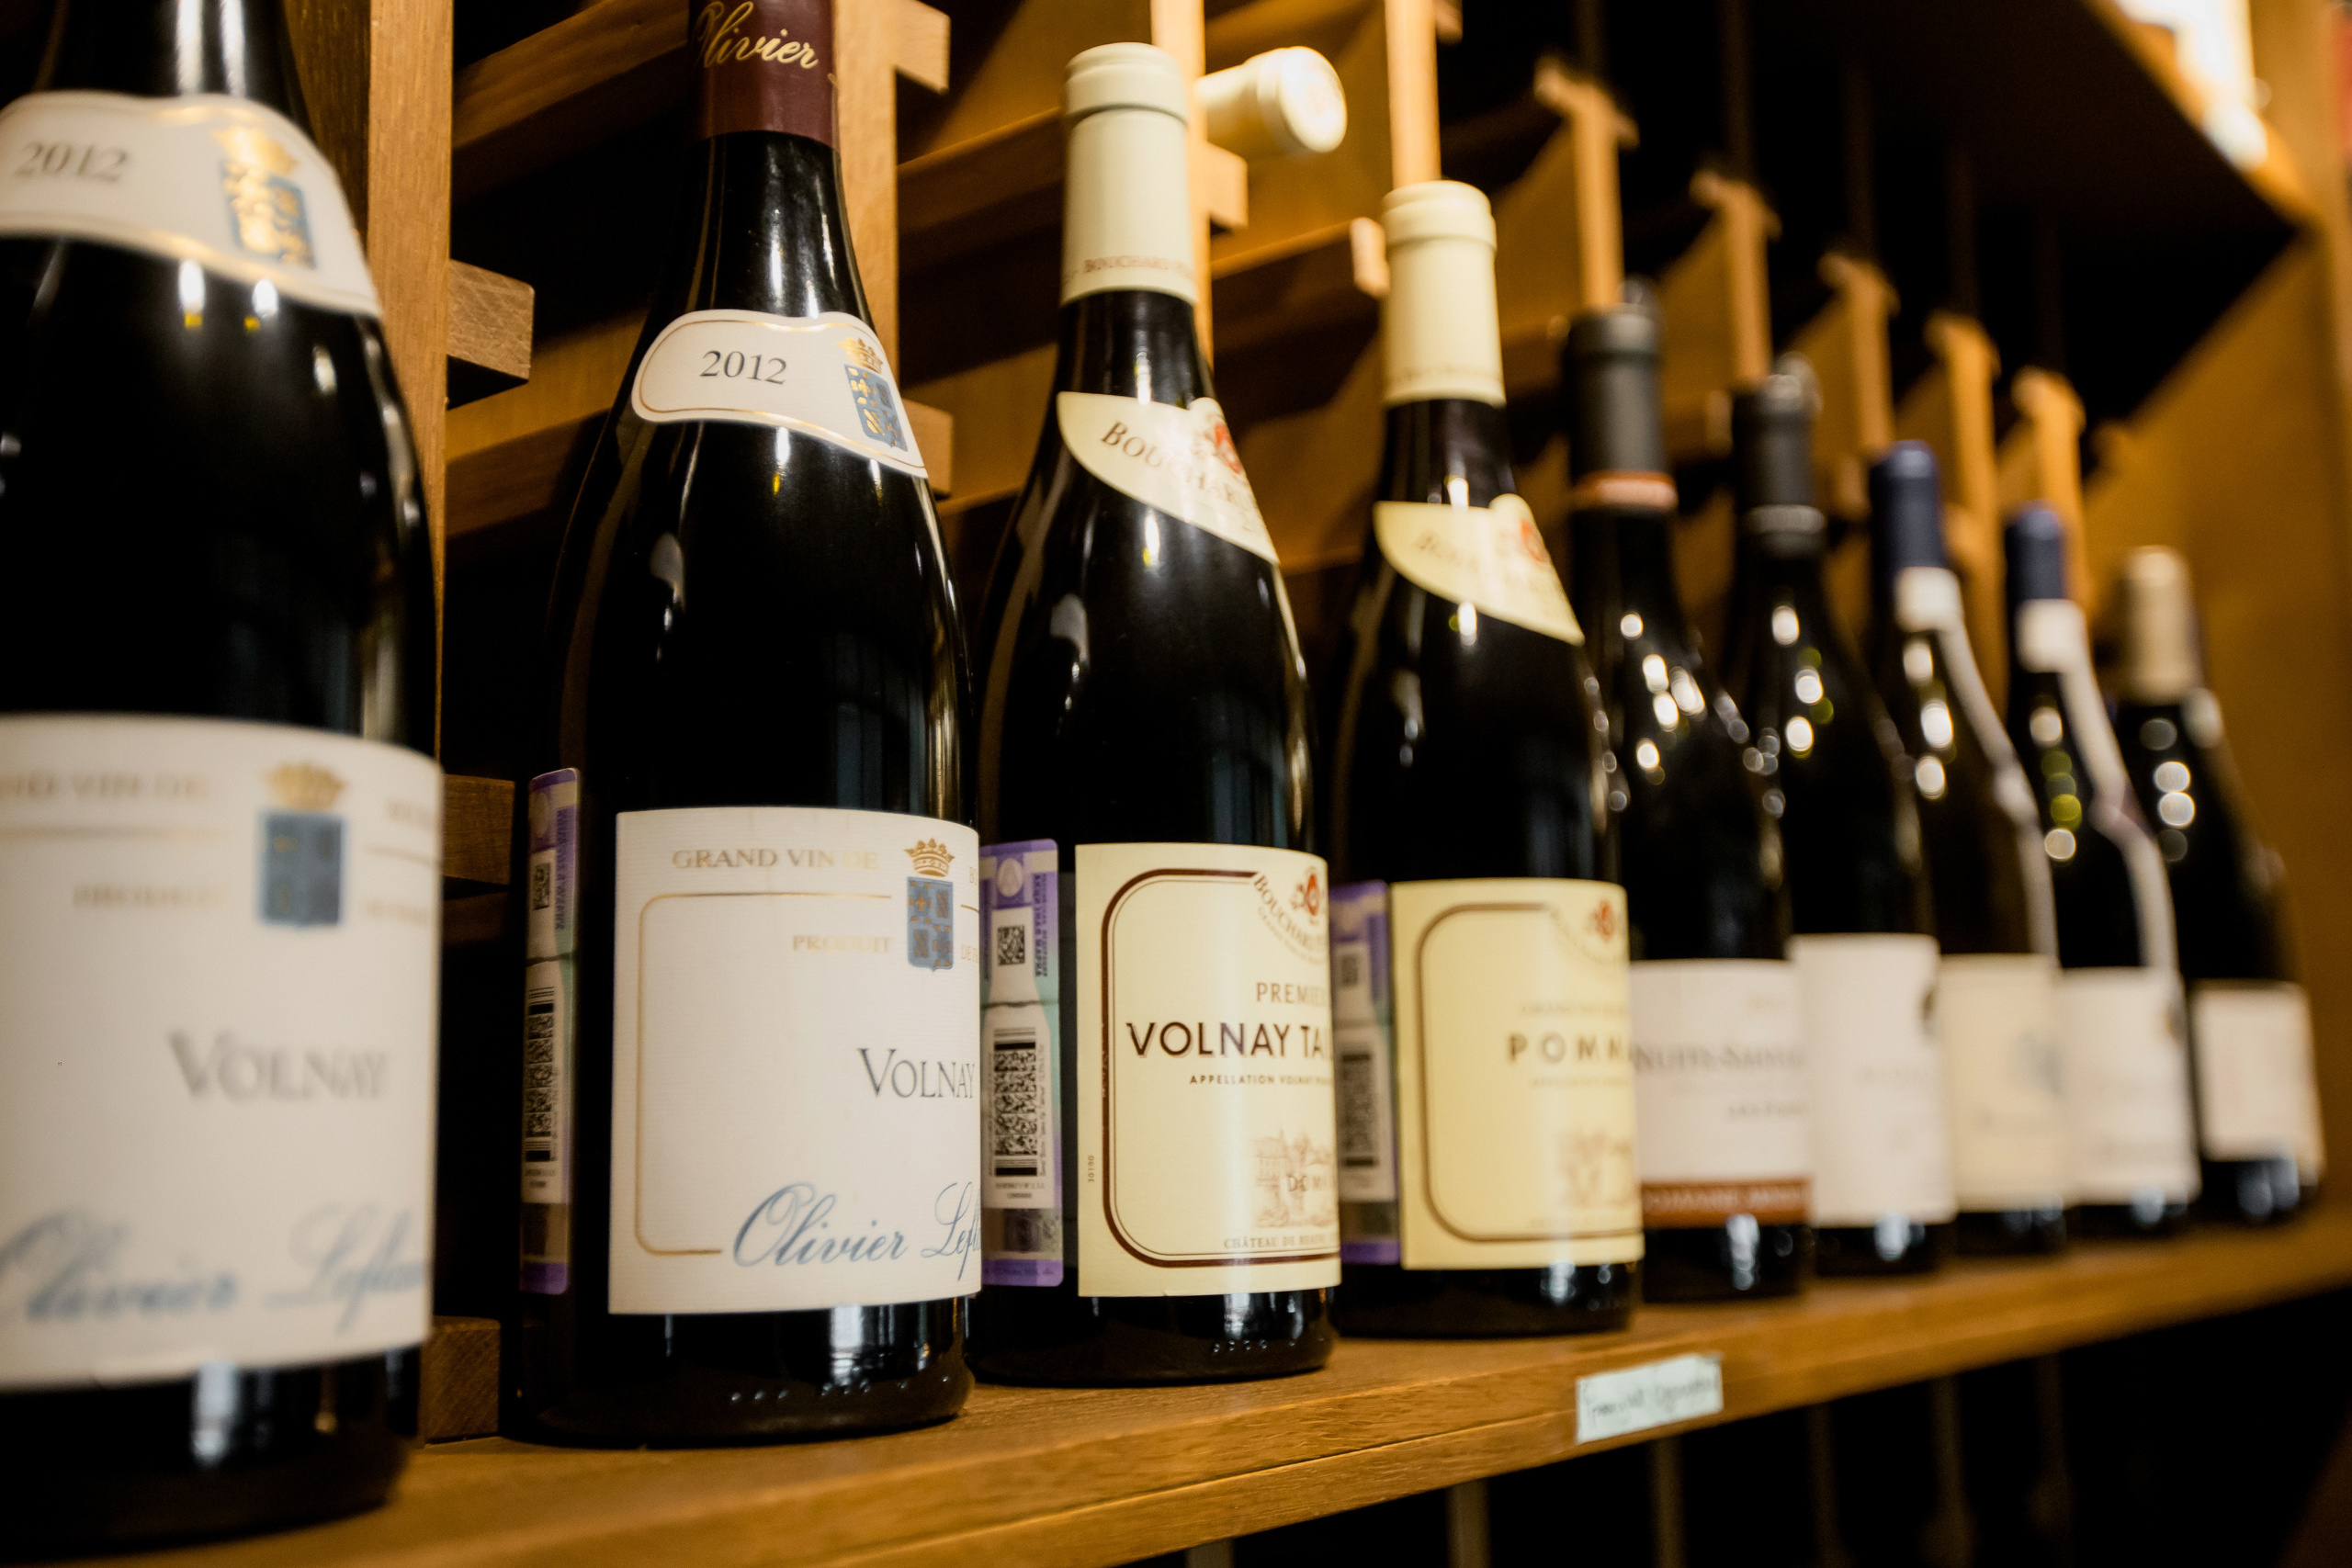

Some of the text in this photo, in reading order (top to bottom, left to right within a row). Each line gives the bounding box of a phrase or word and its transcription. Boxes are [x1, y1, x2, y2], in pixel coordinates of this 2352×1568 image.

[14, 141, 129, 182] 2012
[699, 350, 786, 385] 2012
[672, 849, 878, 870] GRAND VIN DE
[792, 935, 891, 953] PRODUIT
[1126, 1022, 1289, 1056] VOLNAY
[1190, 1075, 1274, 1085] APPELLATION
[733, 1182, 909, 1267] Olivier
